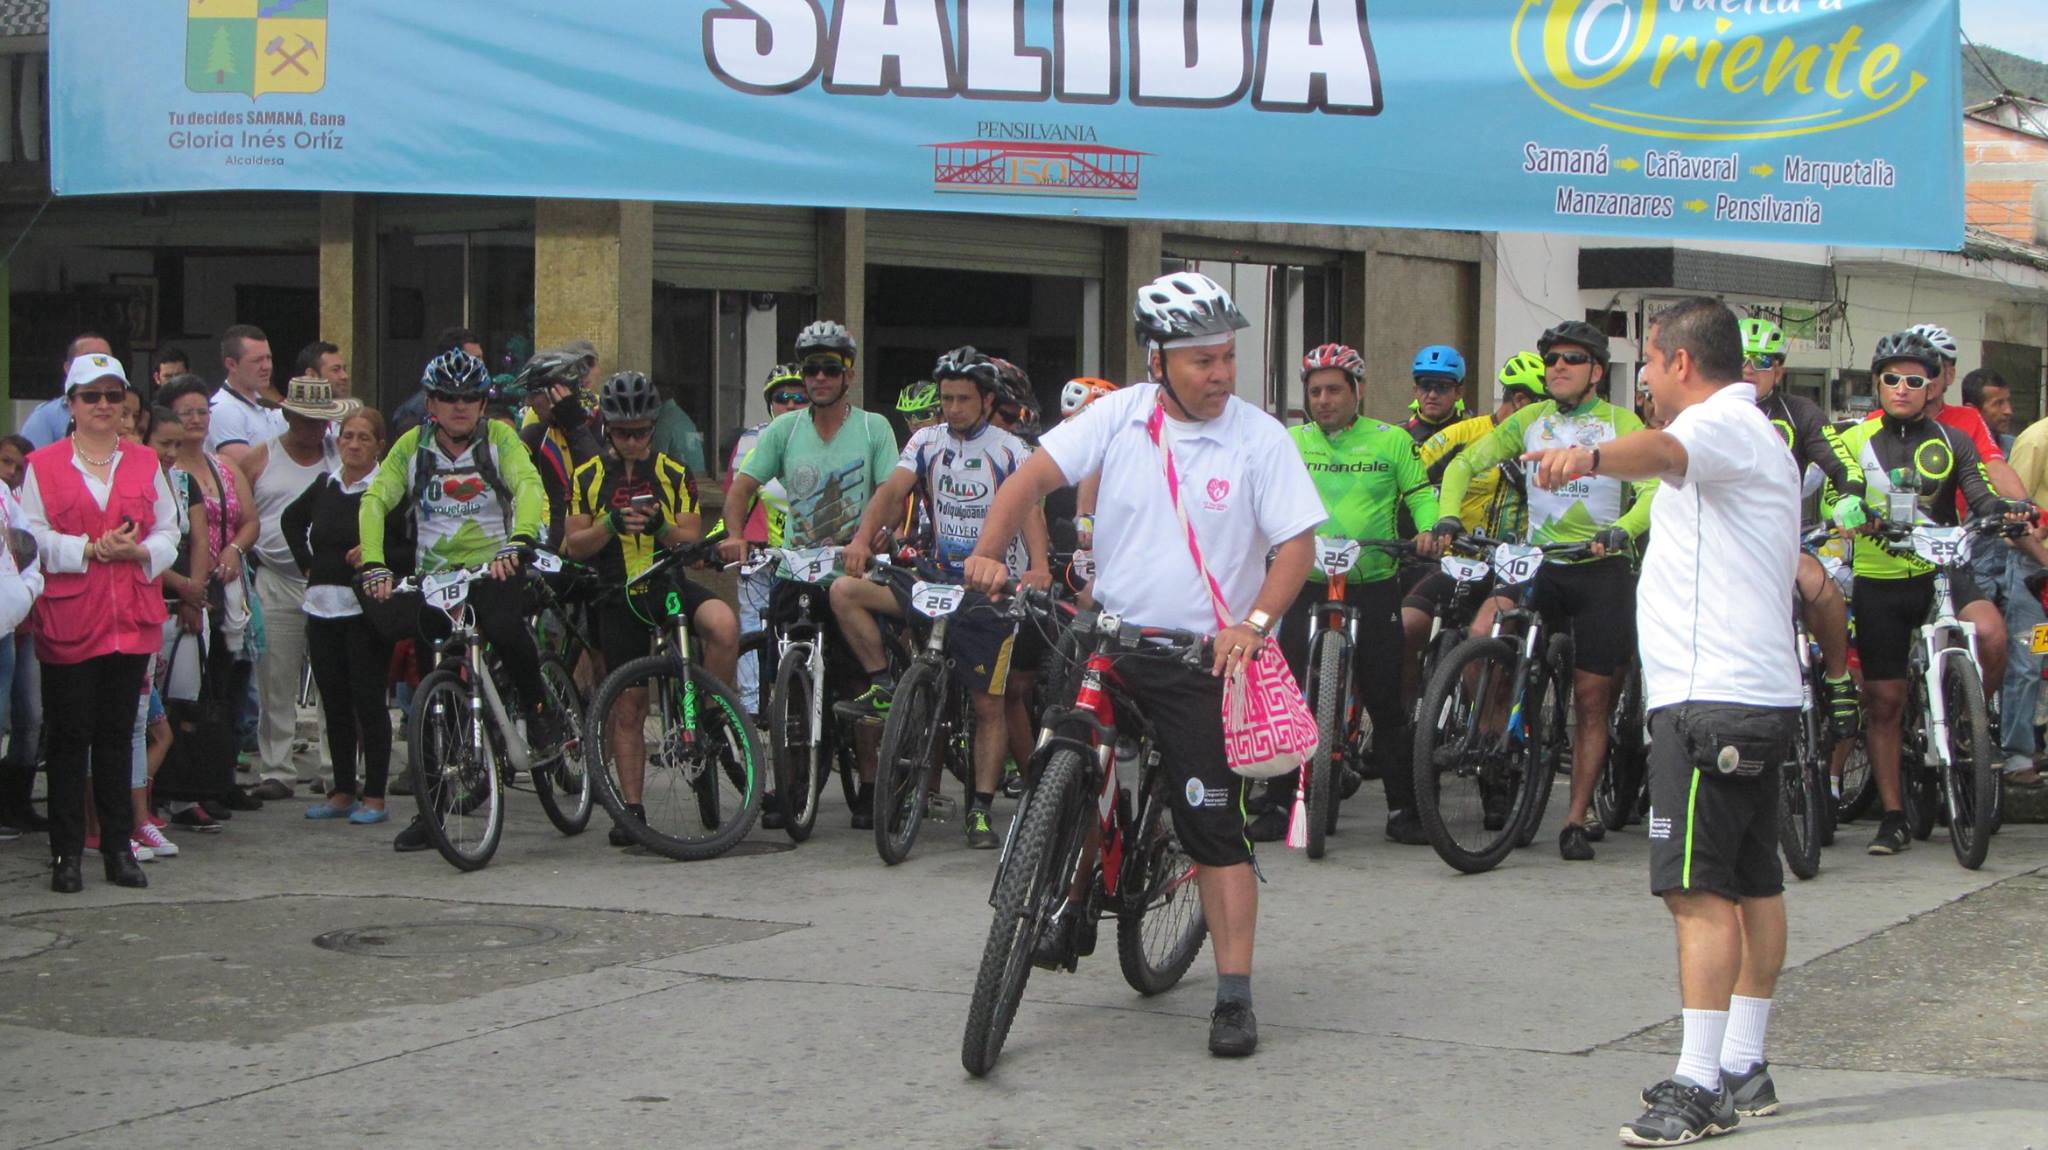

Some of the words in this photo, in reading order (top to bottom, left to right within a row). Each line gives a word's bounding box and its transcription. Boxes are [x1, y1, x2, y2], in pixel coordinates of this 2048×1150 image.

[1543, 0, 1901, 101] Oriente
[168, 111, 185, 126] Tu
[187, 111, 244, 126] decides
[310, 111, 346, 126] Gana
[168, 130, 234, 150] Gloria
[241, 128, 286, 149] Inés
[293, 129, 344, 150] Ortíz
[976, 120, 1098, 143] PENSILVANIA
[225, 155, 285, 166] Alcaldesa
[1524, 143, 1609, 176] Samaná
[1644, 150, 1739, 181] Cañaveral
[1783, 156, 1895, 189] Marquetalia
[1010, 158, 1068, 186] 150
[1555, 186, 1673, 218] Manzanares
[1714, 193, 1821, 225] Pensilvania
[1304, 459, 1390, 474] nnondale
[1323, 551, 1350, 568] 25
[1509, 559, 1529, 576] 10
[441, 584, 461, 601] 18
[925, 596, 953, 610] 26
